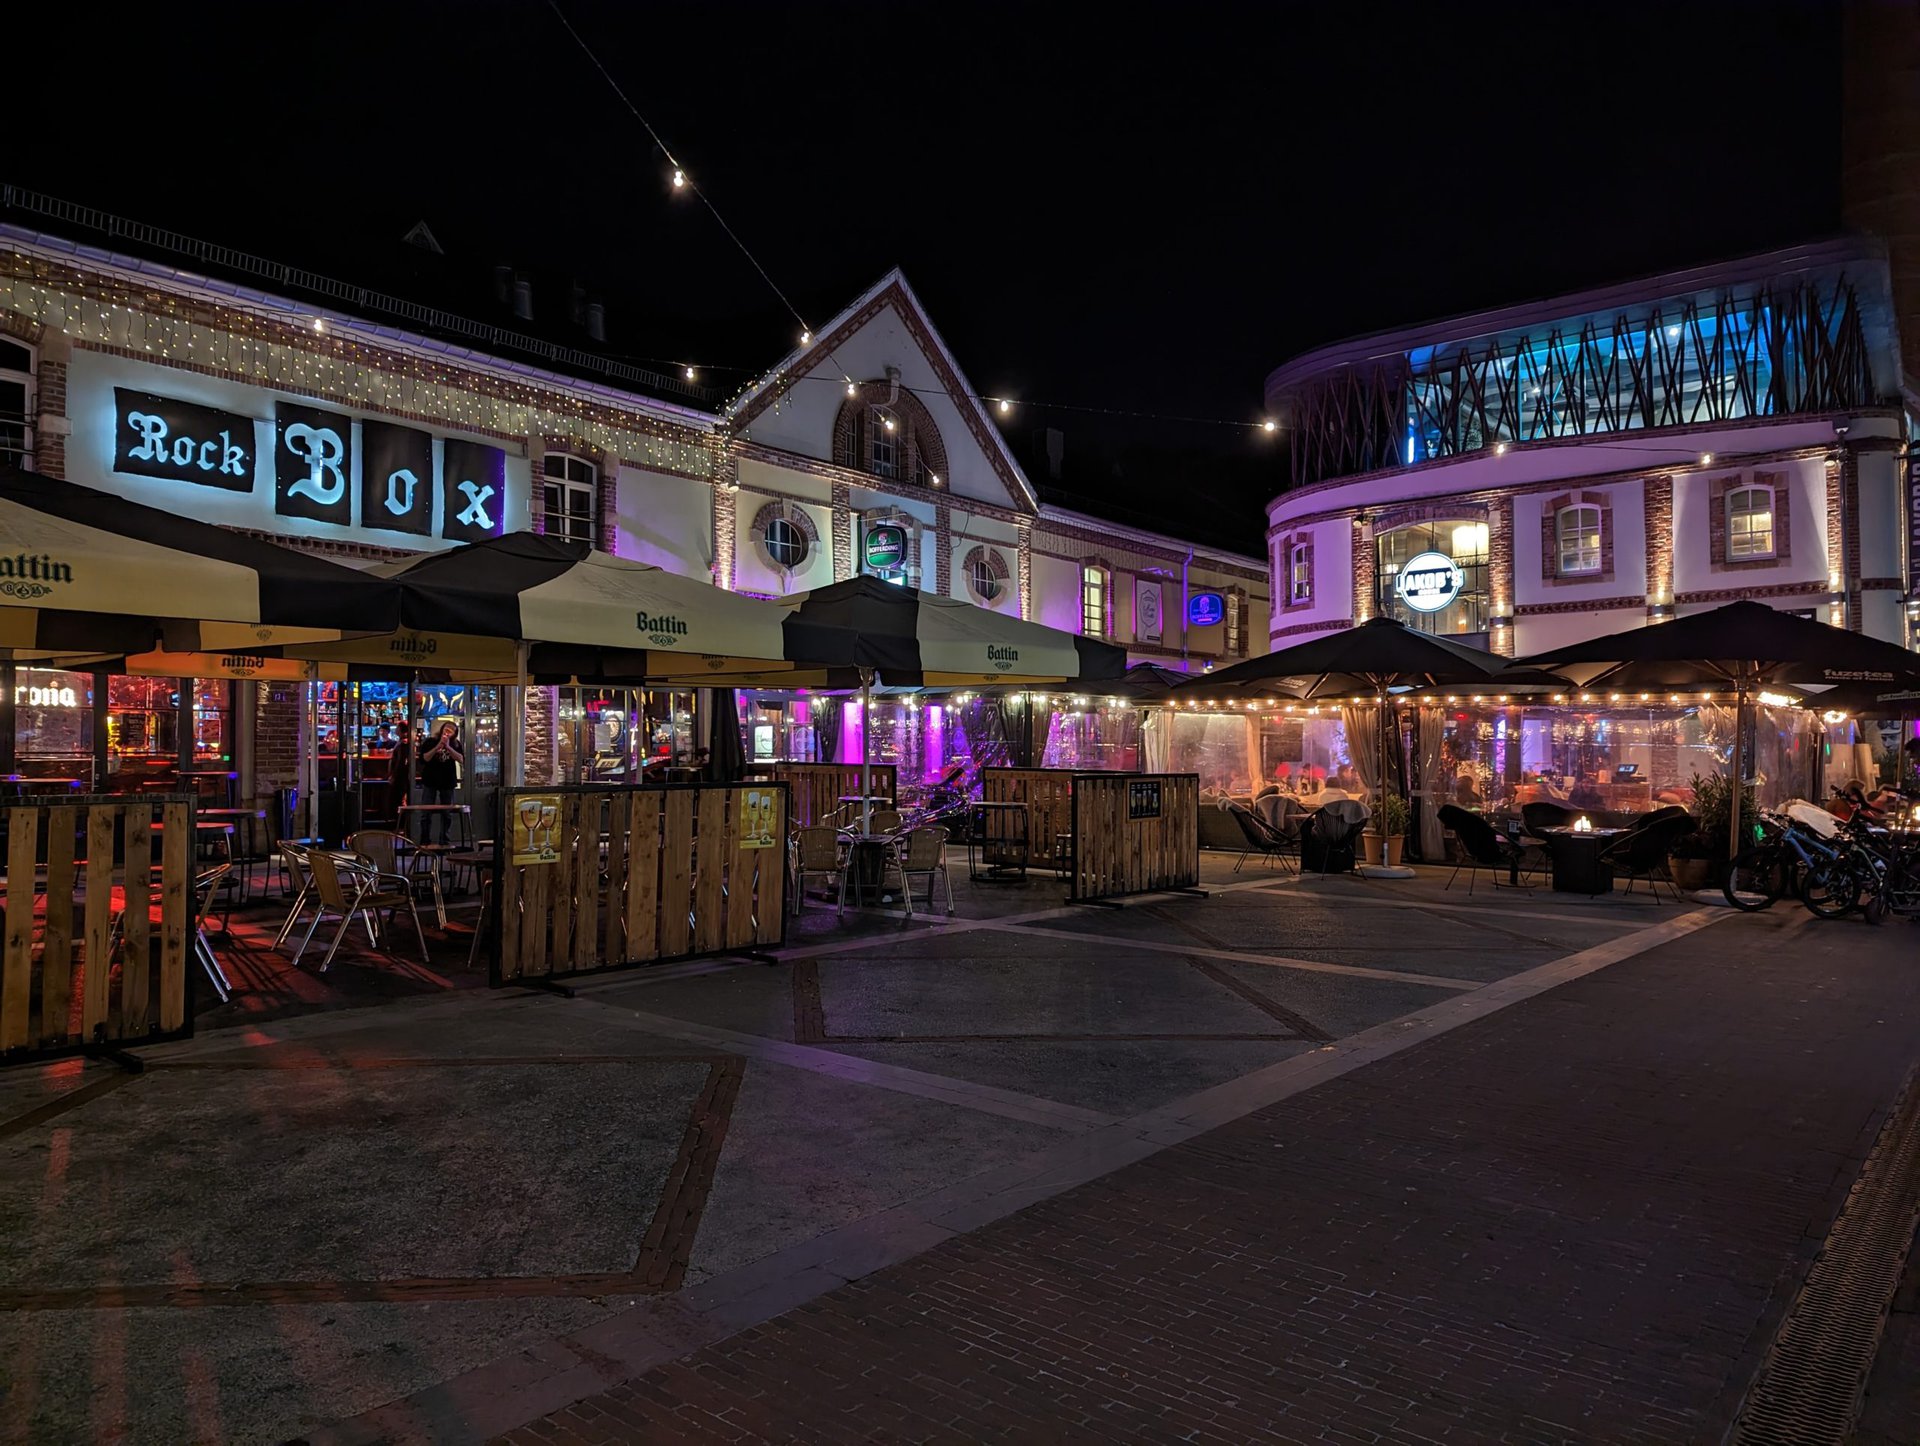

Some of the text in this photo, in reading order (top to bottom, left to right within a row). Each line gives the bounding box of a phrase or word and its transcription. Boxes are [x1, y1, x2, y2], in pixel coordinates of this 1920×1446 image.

[127, 411, 495, 530] Rock Box
[0, 554, 74, 583] attin
[636, 610, 688, 635] Battin
[987, 644, 1018, 661] Battin
[15, 686, 77, 707] rona
